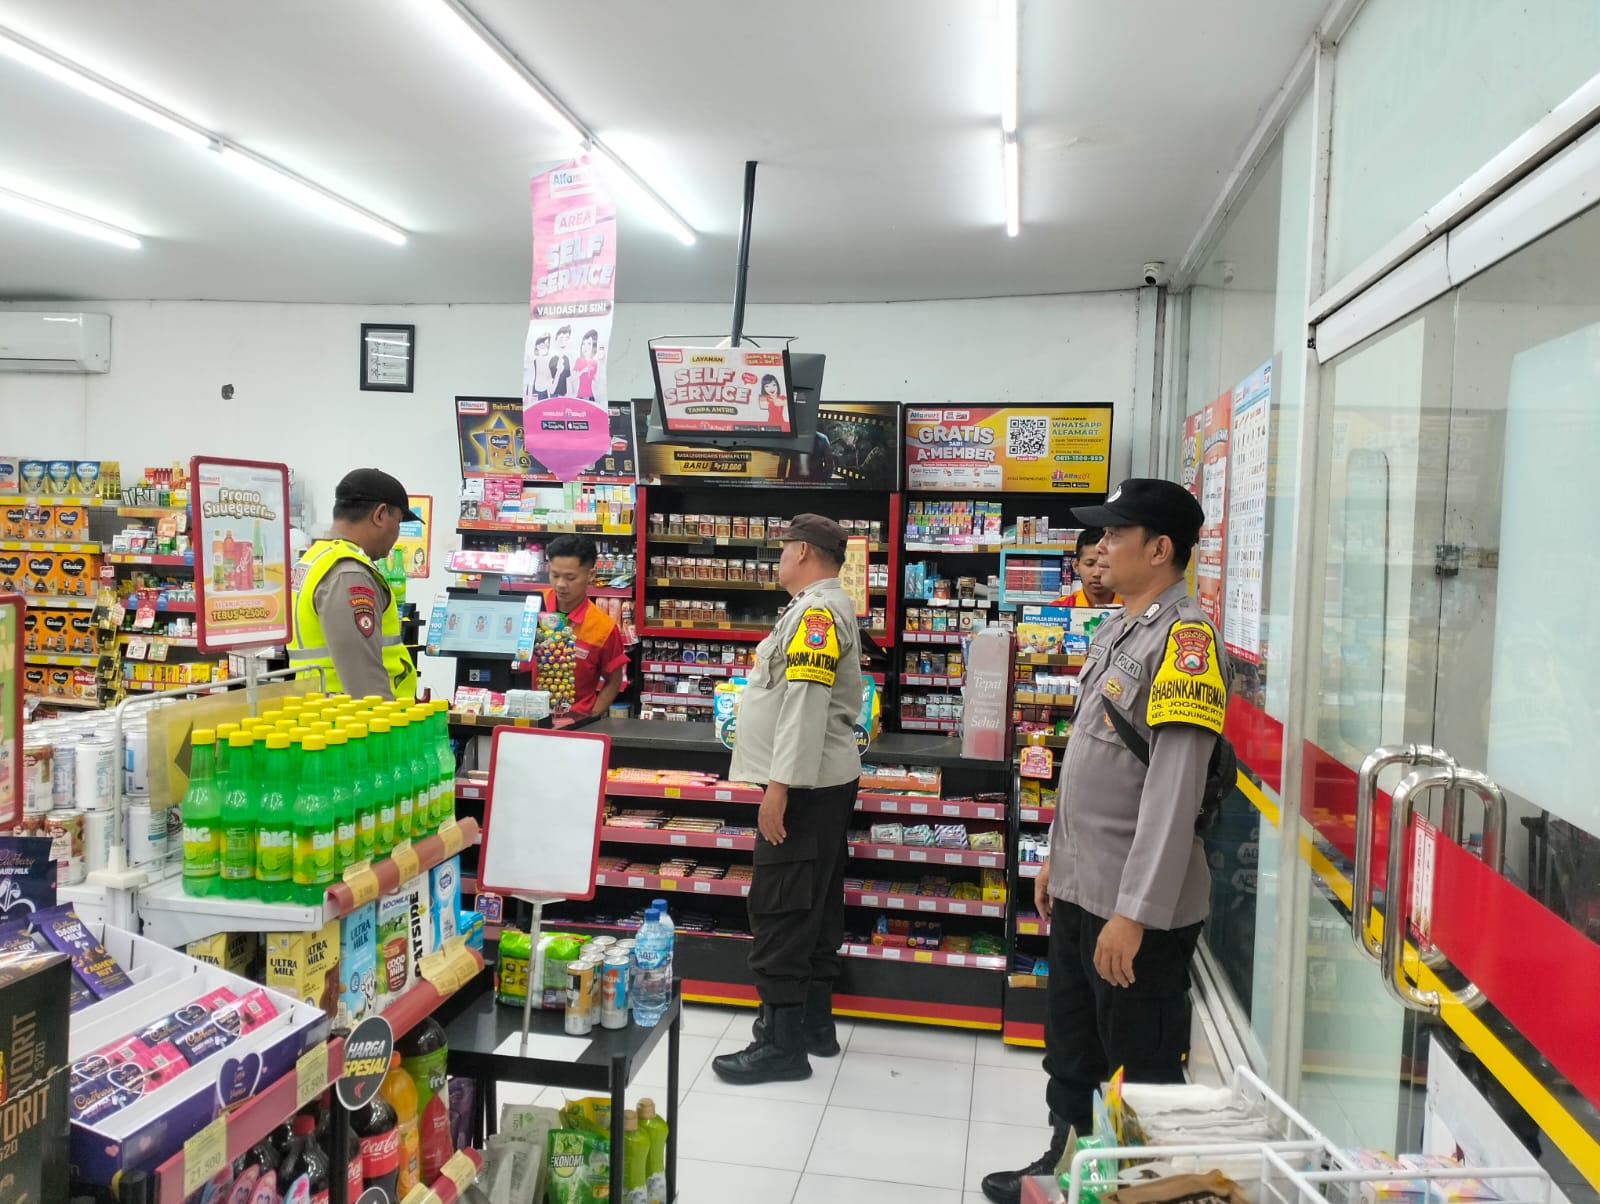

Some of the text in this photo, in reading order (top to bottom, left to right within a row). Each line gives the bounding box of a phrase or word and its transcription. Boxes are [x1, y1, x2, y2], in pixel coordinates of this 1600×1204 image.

[559, 212, 591, 229] AREA
[546, 234, 604, 271] SELF
[536, 264, 614, 298] SERVICE
[537, 303, 606, 316] VALIDASI DI SINI
[675, 367, 736, 387] SELF
[664, 385, 752, 406] SERVICE
[918, 426, 994, 444] GRATIS
[220, 488, 260, 503] Promo
[212, 610, 239, 621] TEBUS
[1118, 655, 1138, 675] POLRI
[974, 676, 1001, 692] Tepat
[970, 715, 1000, 728] Sehat
[260, 831, 291, 848] BIG
[56, 923, 82, 937] DAIRY
[63, 931, 86, 943] MILK
[351, 920, 371, 940] ULTRA
[305, 940, 328, 958] ULTRA
[353, 933, 369, 950] MILK
[270, 958, 298, 968] ULTRA
[307, 951, 325, 966] MILK
[639, 951, 658, 959] AQUA
[97, 967, 113, 977] NUT
[273, 967, 294, 976] MILK
[347, 1040, 386, 1057] HARGA
[343, 1057, 388, 1078] SPESIAL
[74, 1087, 114, 1110] Cadbury
[0, 1084, 50, 1142] ORIT
[551, 1155, 584, 1169] EKONOMI
